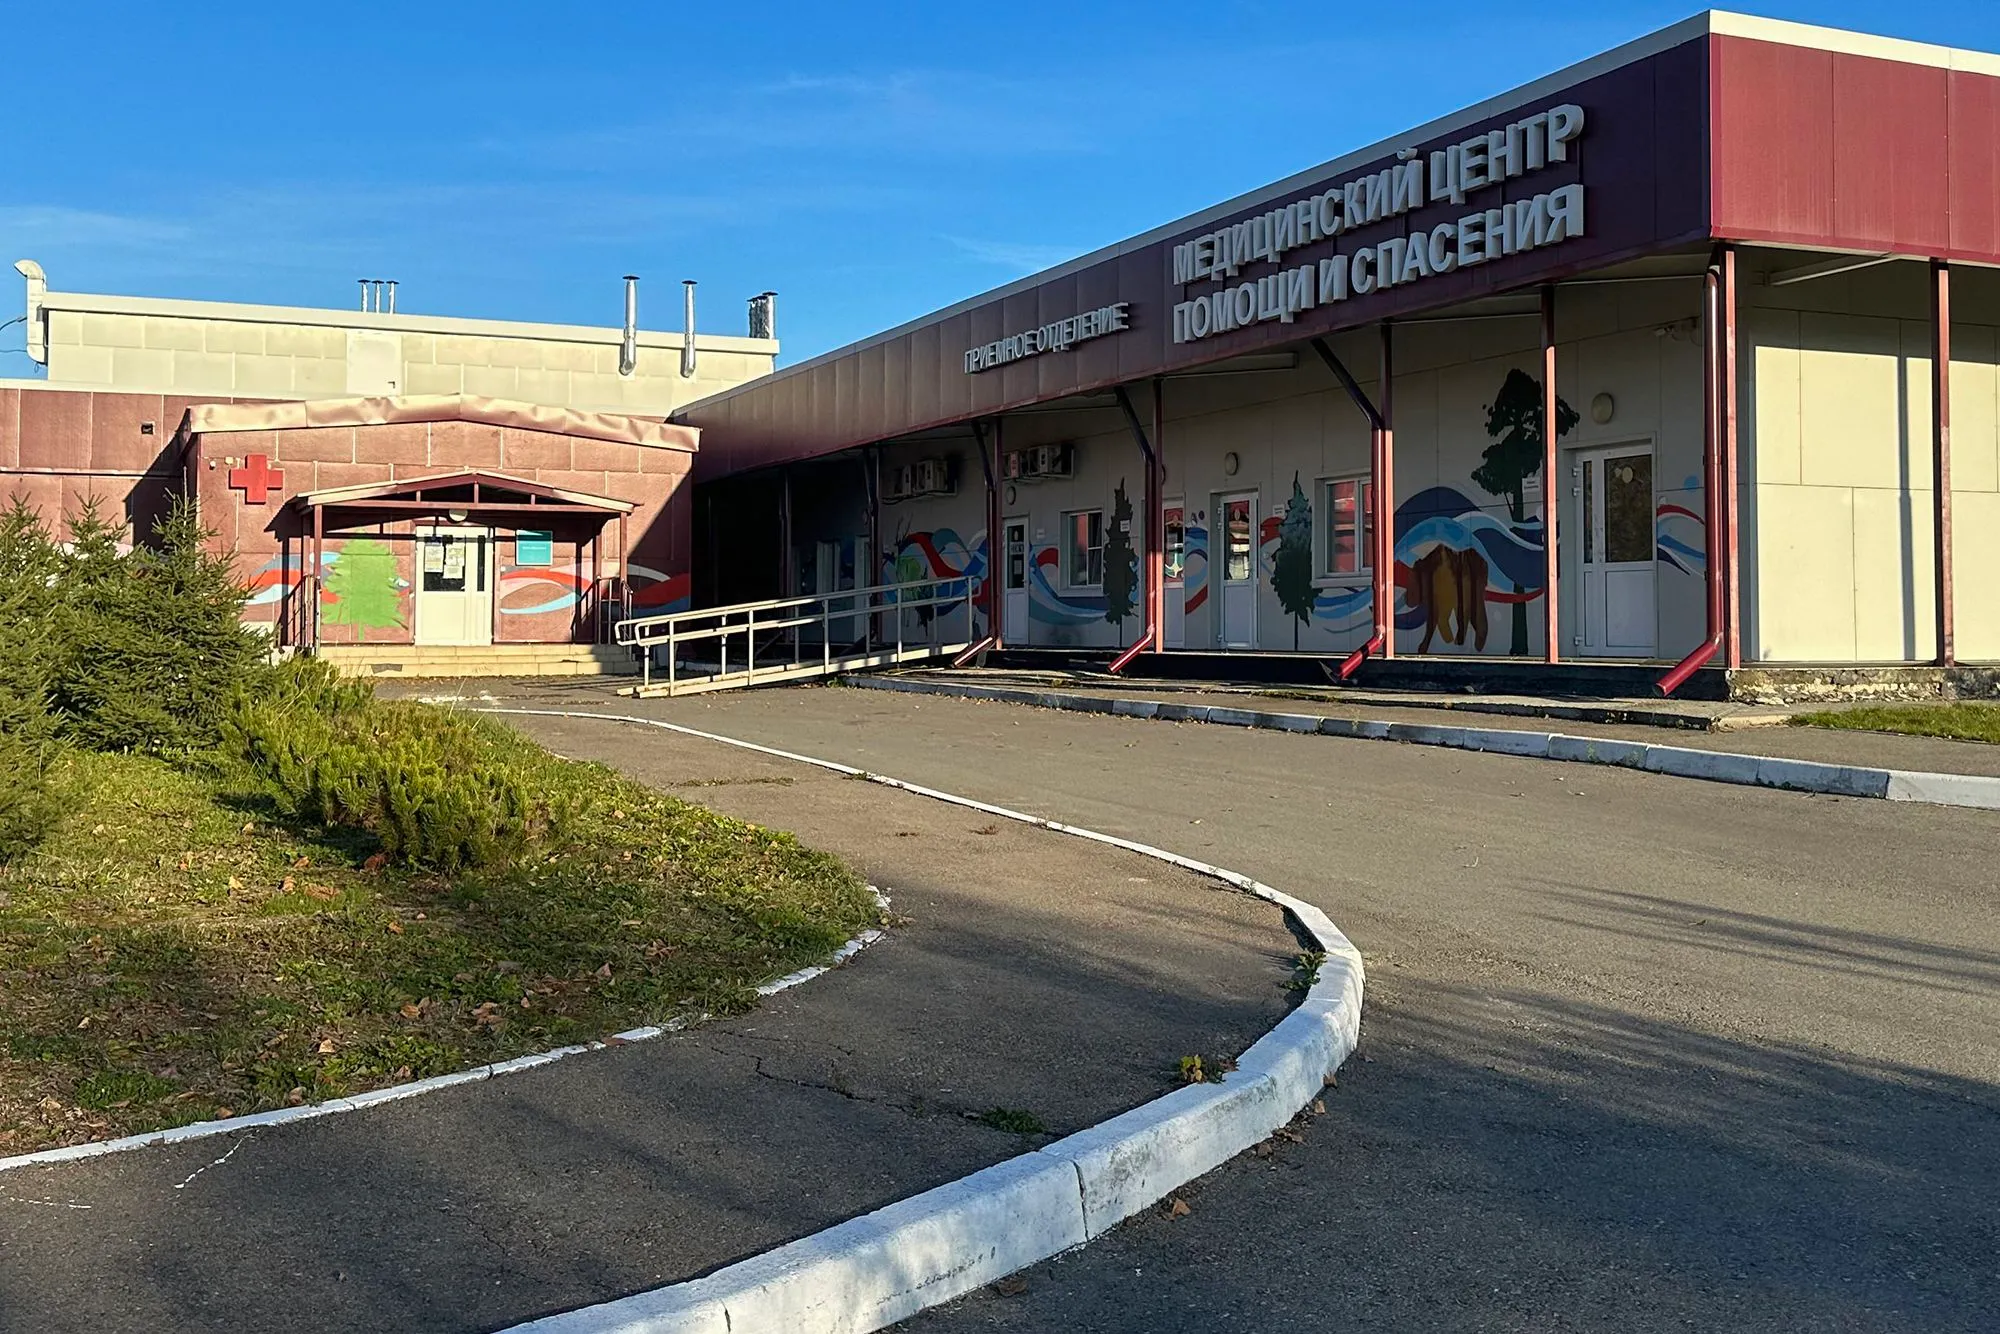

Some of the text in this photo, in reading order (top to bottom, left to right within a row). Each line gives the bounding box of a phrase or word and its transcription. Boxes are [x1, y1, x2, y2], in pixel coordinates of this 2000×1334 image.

[1173, 104, 1584, 285] МЕДИЦИНСКИЙ ЦЕНТР
[1173, 184, 1584, 344] ПОМОЩИ И СПАСЕНИЯ
[965, 302, 1128, 373] ПРИЕМНОЕ ОТДЕЛЕНИЕ
